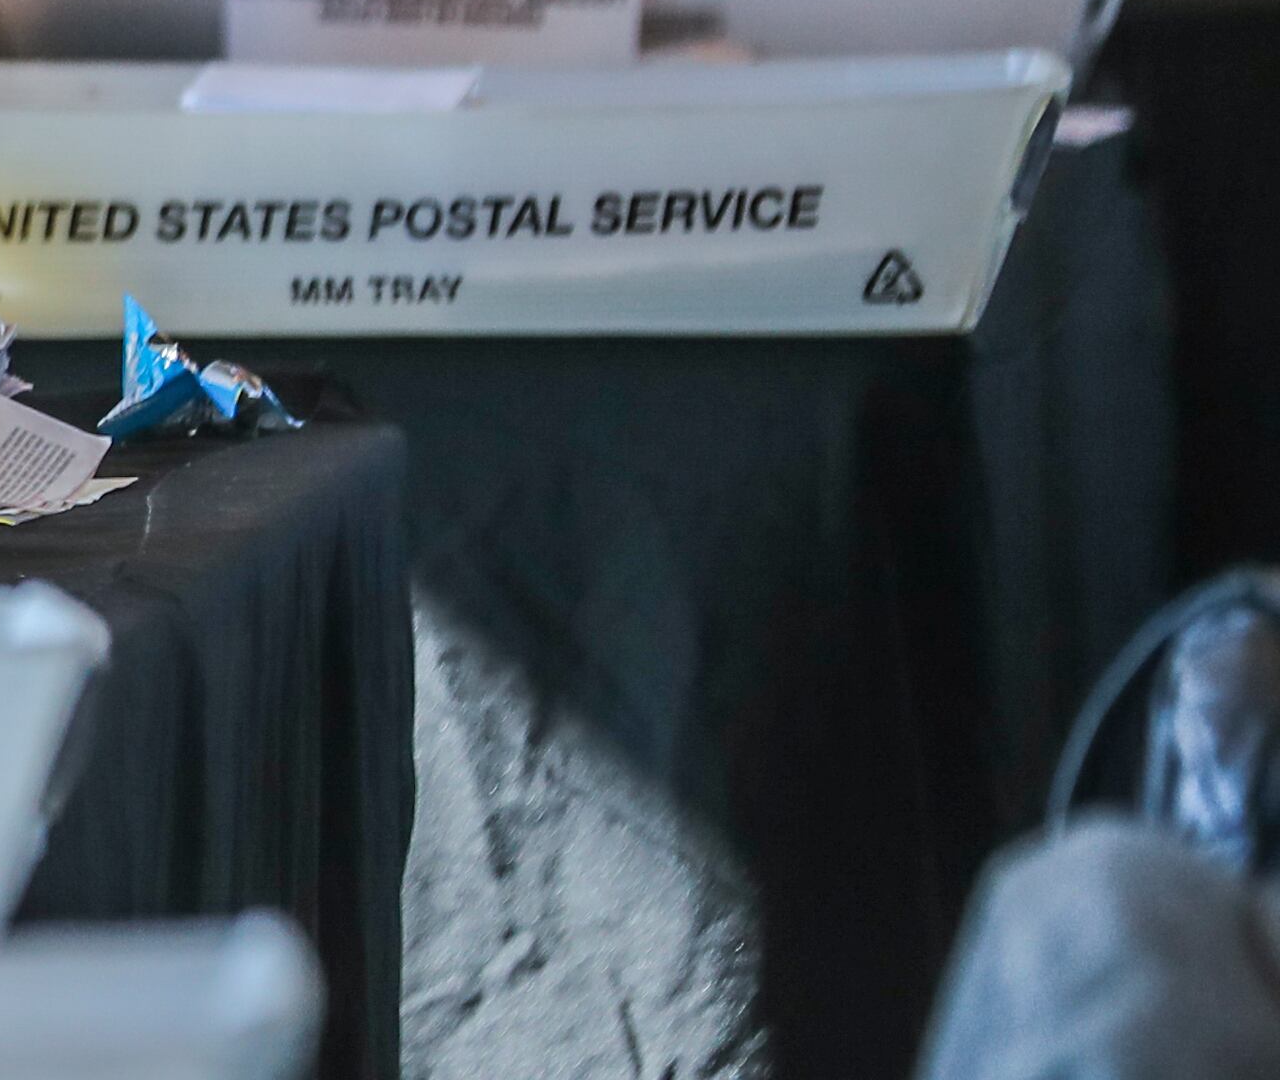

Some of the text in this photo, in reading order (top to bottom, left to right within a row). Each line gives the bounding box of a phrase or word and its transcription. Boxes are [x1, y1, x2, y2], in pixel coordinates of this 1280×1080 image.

[154, 196, 353, 244] STATES
[367, 193, 575, 242] POSTAL
[589, 184, 825, 238] SERVICE
[290, 273, 465, 307] MM TRAY
